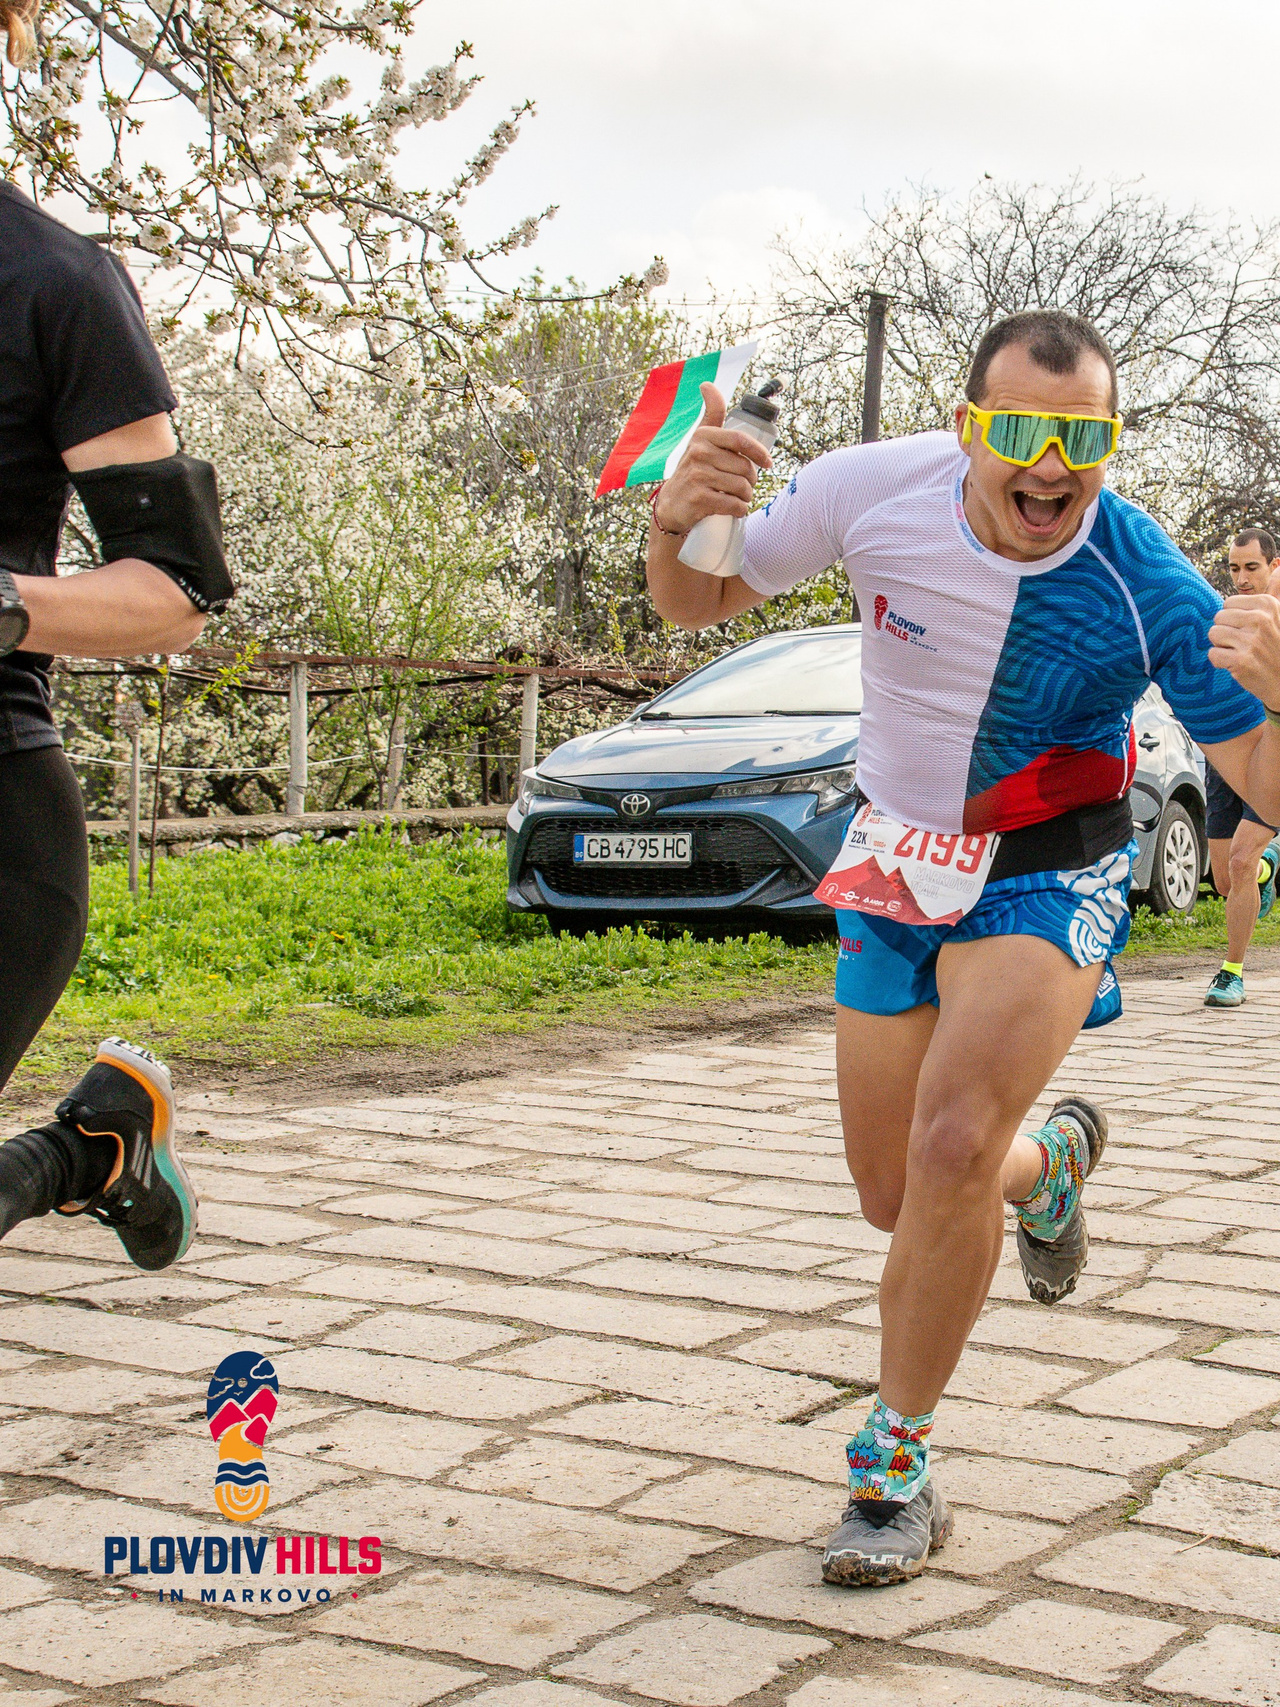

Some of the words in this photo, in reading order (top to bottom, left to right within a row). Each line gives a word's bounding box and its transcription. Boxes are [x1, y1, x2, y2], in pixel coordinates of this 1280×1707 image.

[885, 621, 909, 641] HILLS
[887, 611, 927, 637] PLOVDIV
[851, 830, 868, 845] 22K
[587, 838, 611, 858] CB
[614, 838, 659, 859] 4795
[663, 838, 687, 858] HC
[893, 824, 988, 874] 2199
[911, 880, 940, 899] TRAIL
[913, 866, 976, 894] MARKOVO
